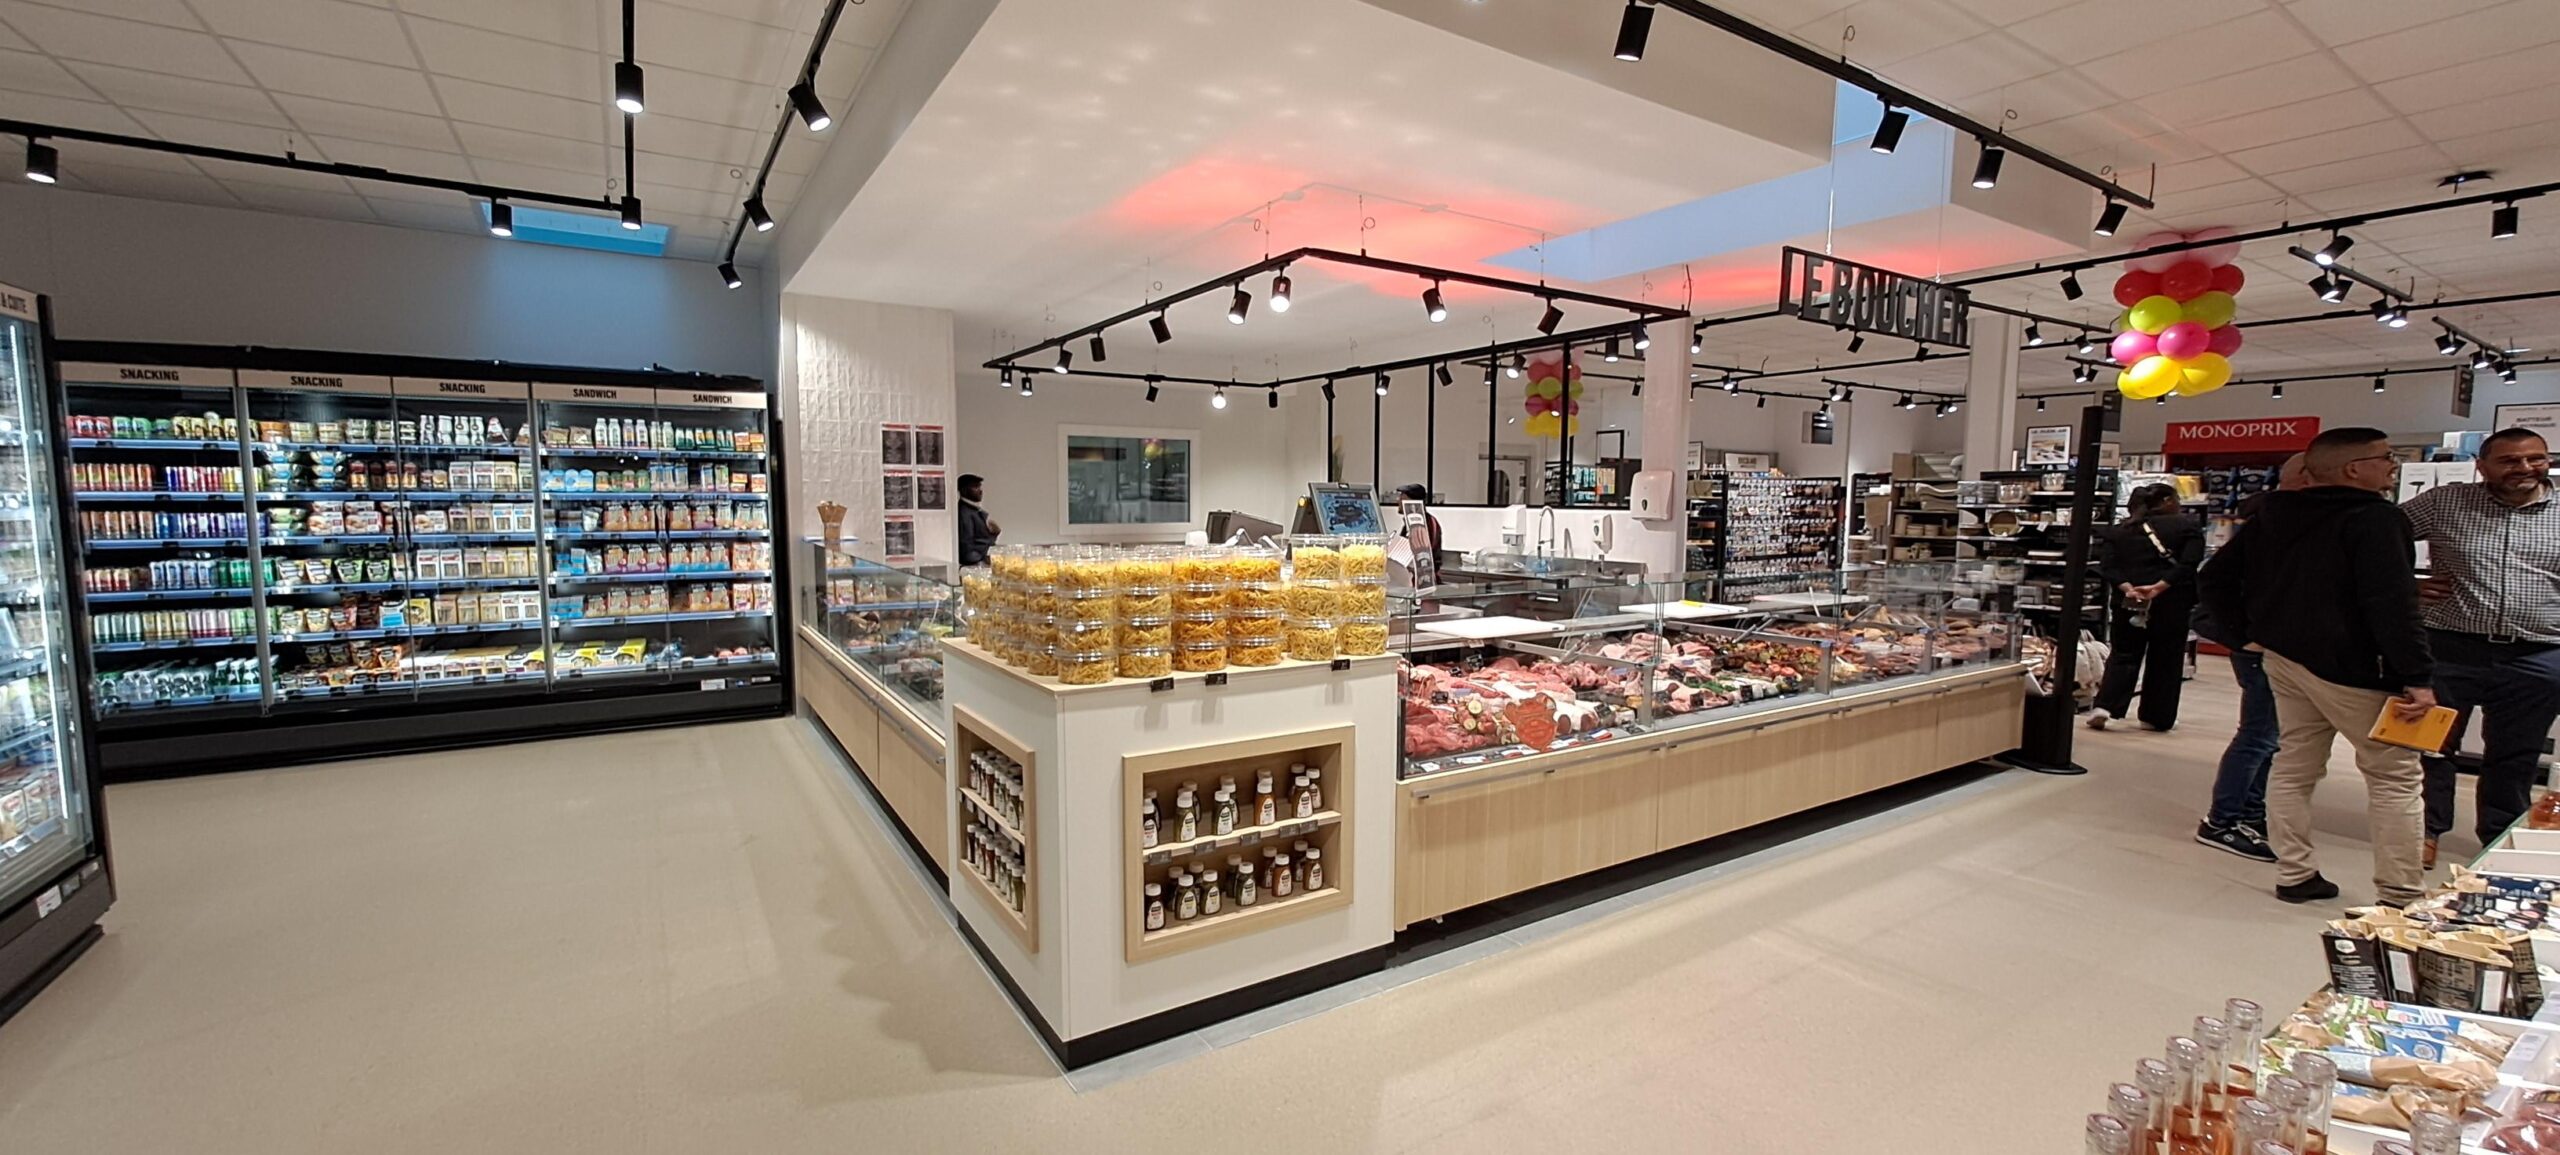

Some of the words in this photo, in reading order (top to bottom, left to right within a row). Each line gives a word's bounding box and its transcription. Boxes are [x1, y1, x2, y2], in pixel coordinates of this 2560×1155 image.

[1779, 248, 1824, 319] LE
[1828, 260, 1970, 346] BOUCHER
[120, 368, 179, 381] SNACKING
[291, 375, 343, 388] SNACKING
[439, 382, 486, 394] SNACKING
[573, 388, 617, 399] SANDWICH
[692, 393, 733, 404] SANDWICH
[2179, 421, 2299, 440] MONOPRIX
